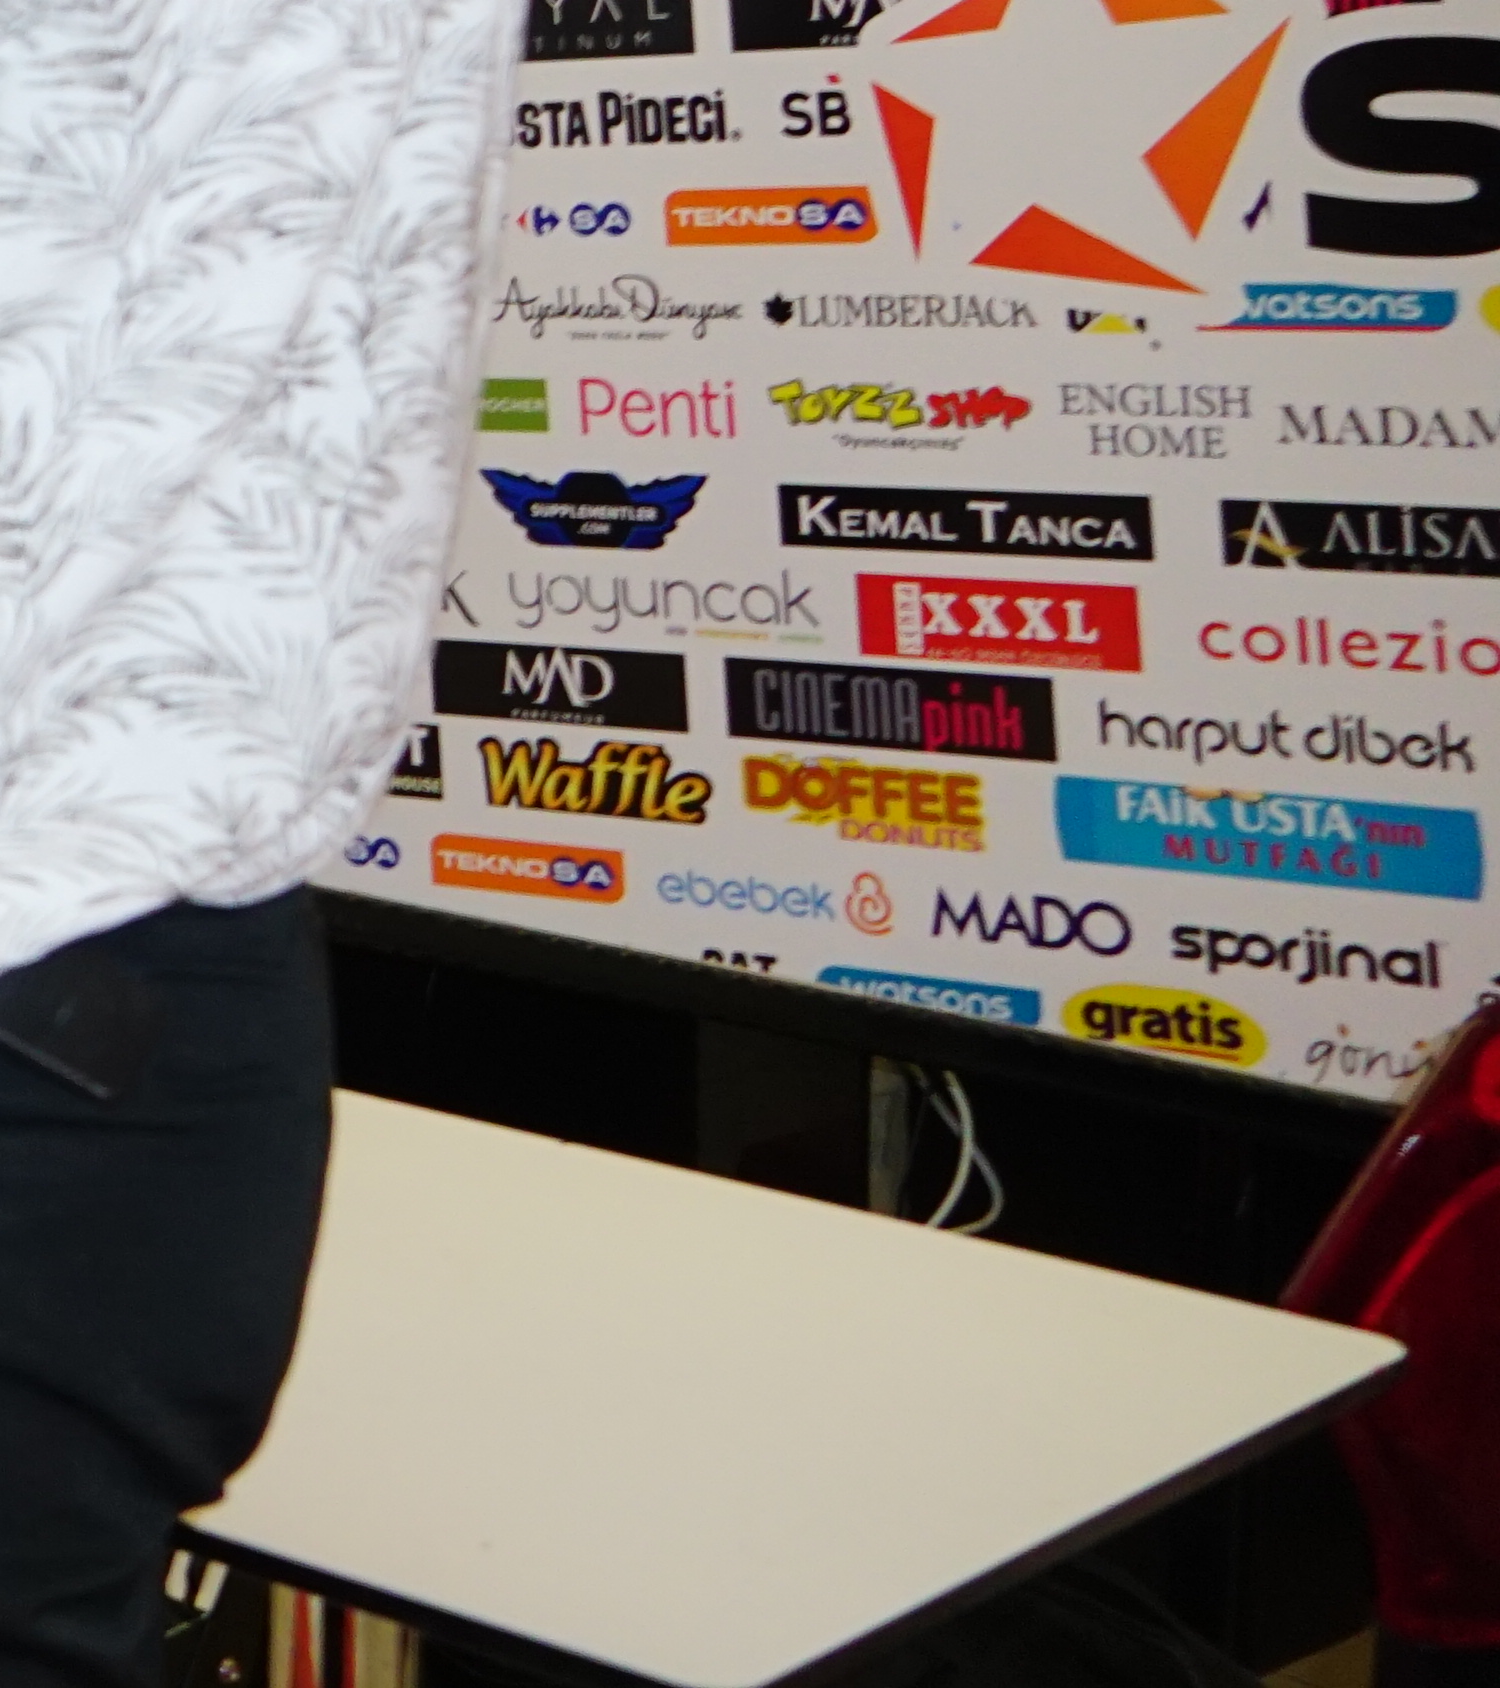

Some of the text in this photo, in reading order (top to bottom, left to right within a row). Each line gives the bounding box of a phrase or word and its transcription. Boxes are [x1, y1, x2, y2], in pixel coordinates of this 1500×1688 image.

[670, 200, 867, 232] TEKNOSA
[796, 294, 1038, 330] LUMBERJACK
[579, 375, 737, 439] Penti
[1059, 382, 1253, 419] ENGLISH
[1088, 424, 1229, 460] HOME
[797, 494, 1138, 551] KEMAL TANCA
[507, 568, 821, 634] yoyuncak
[920, 591, 1100, 644] XXXL
[1197, 615, 1500, 676] collezio
[502, 645, 616, 709] MAD
[1099, 698, 1477, 774] harput dibek
[480, 735, 712, 825] Waffle
[743, 757, 985, 827] DOFFEE
[839, 818, 985, 852] DONUTS
[436, 848, 614, 891] TEKNOSA
[657, 869, 836, 923] ebebek
[931, 887, 1133, 957] MADO
[1171, 925, 1441, 989] sporjinal
[1081, 997, 1245, 1052] gratis
